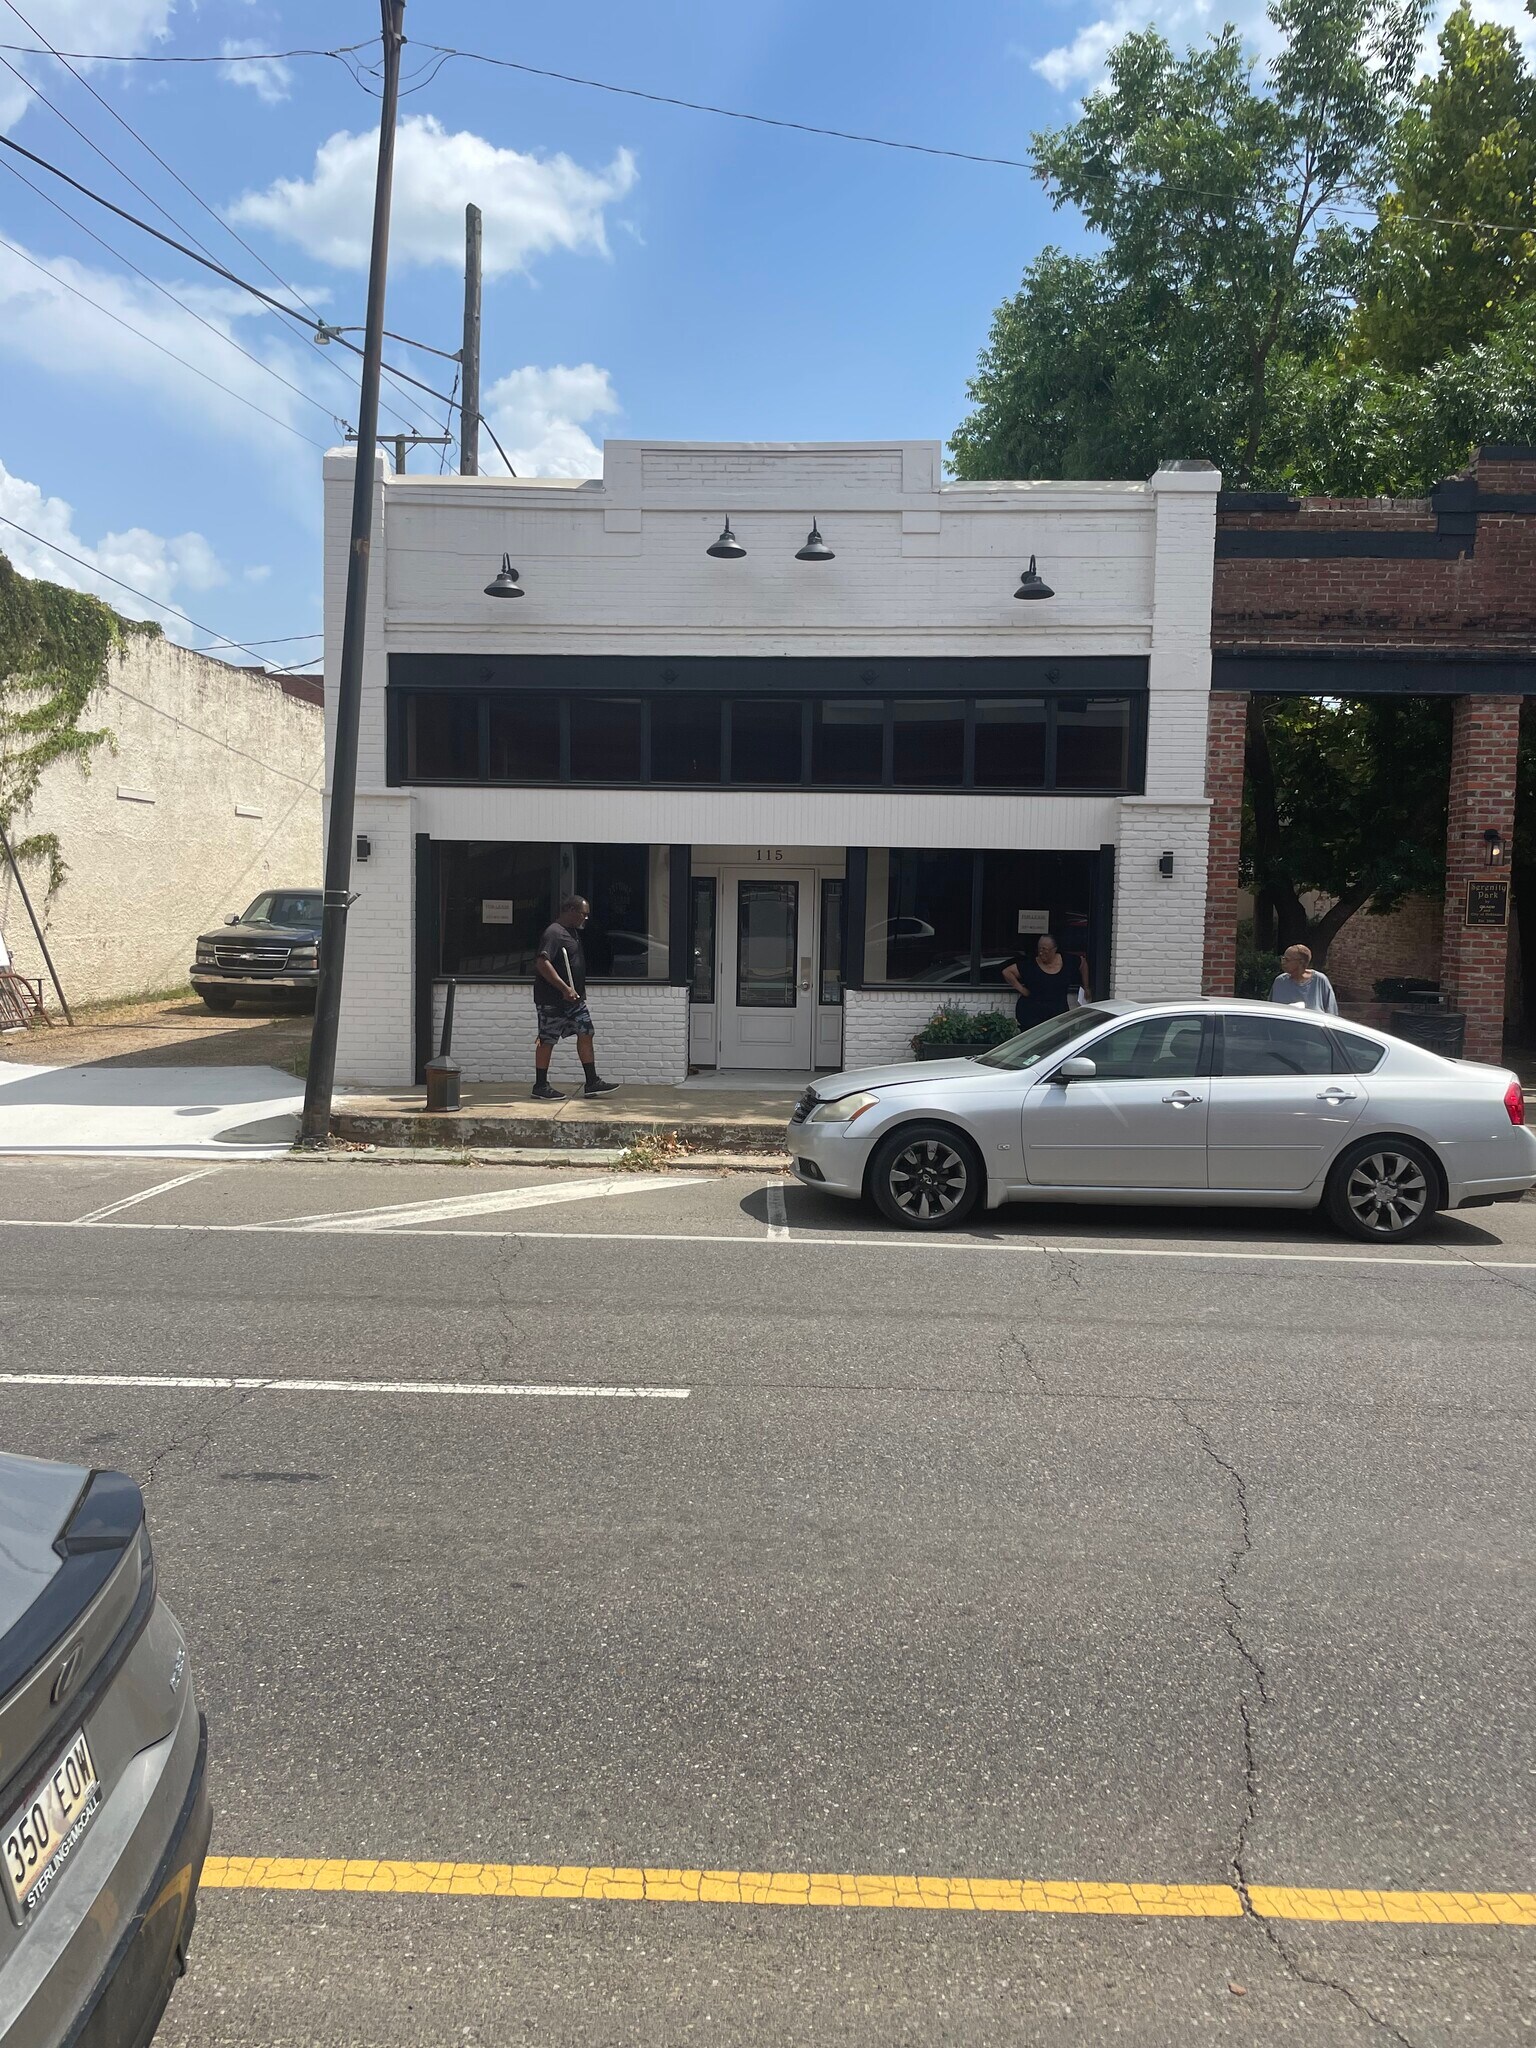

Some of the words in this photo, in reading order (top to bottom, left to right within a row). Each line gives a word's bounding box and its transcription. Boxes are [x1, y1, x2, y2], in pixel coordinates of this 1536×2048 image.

[756, 849, 783, 861] 115
[1471, 883, 1507, 892] Serenity
[1478, 891, 1498, 899] Park
[7, 1802, 50, 1884] 350
[53, 1738, 91, 1819] EOW
[27, 1841, 70, 1908] STERLING
[70, 1796, 100, 1843] McCALL
